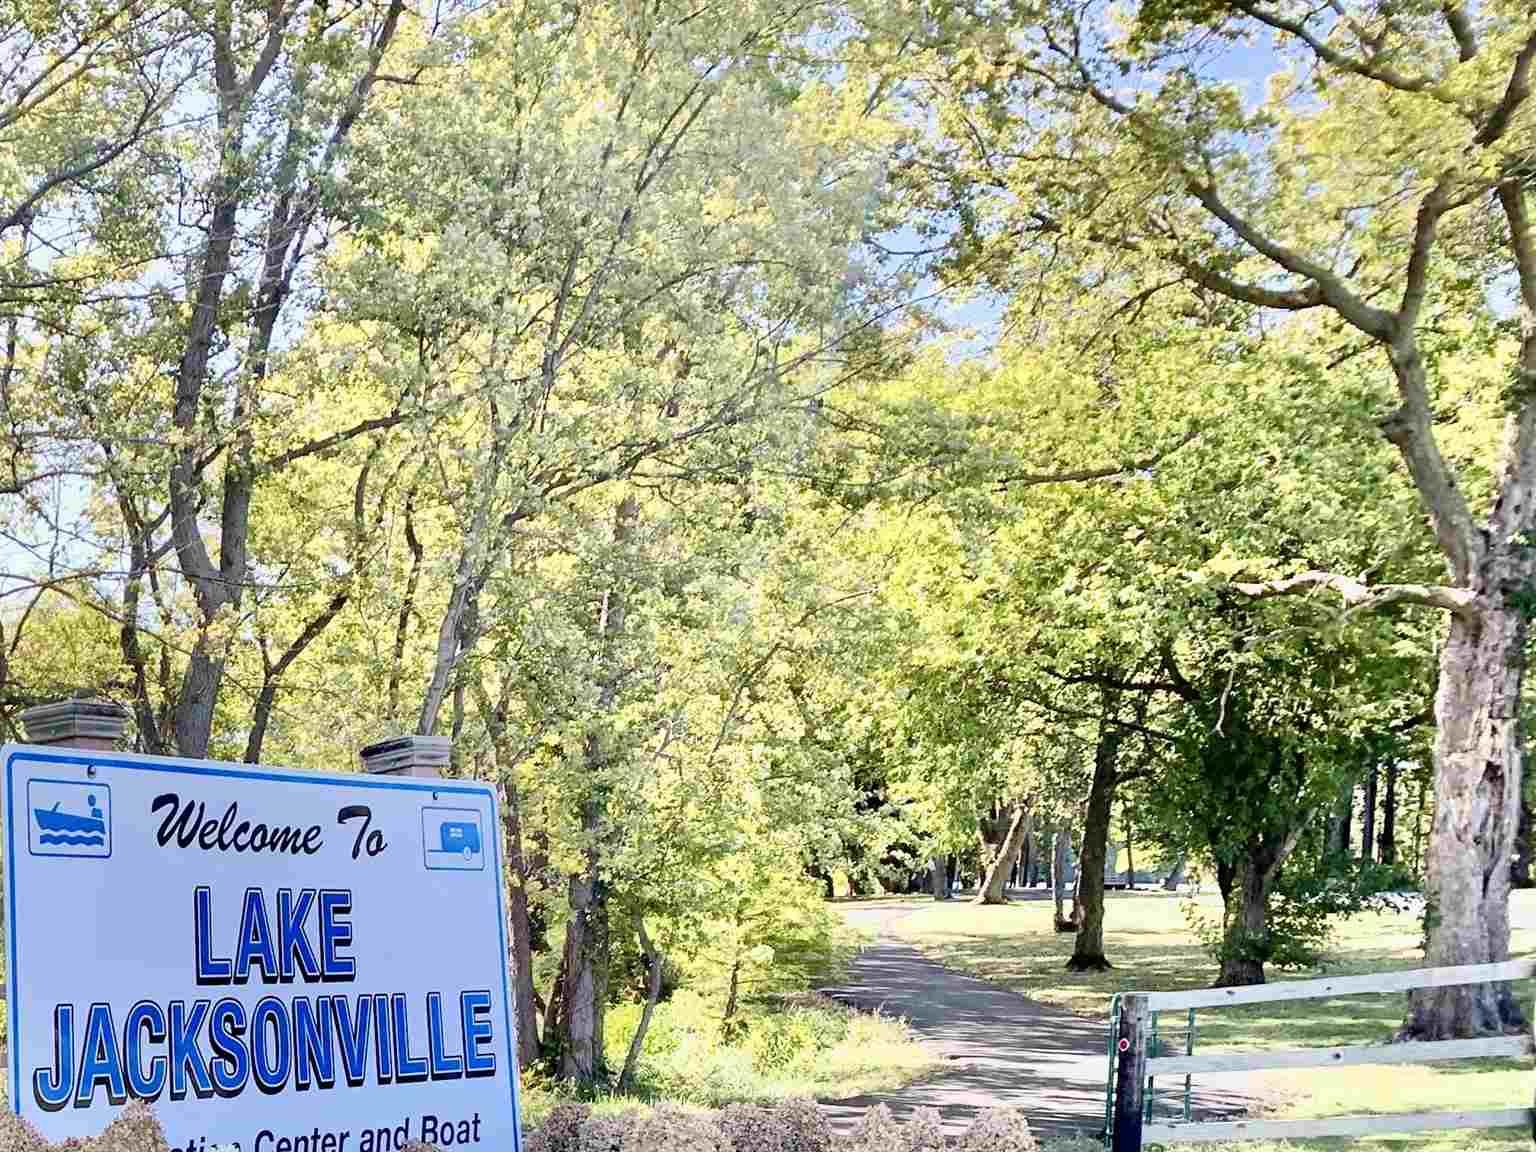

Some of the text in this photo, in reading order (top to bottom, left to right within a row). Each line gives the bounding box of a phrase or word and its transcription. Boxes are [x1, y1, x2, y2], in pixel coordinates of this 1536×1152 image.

[151, 793, 388, 860] Welcome To
[193, 885, 356, 985] LAKE
[33, 988, 497, 1111] JACKSONVILLE
[421, 1112, 481, 1146] Boat
